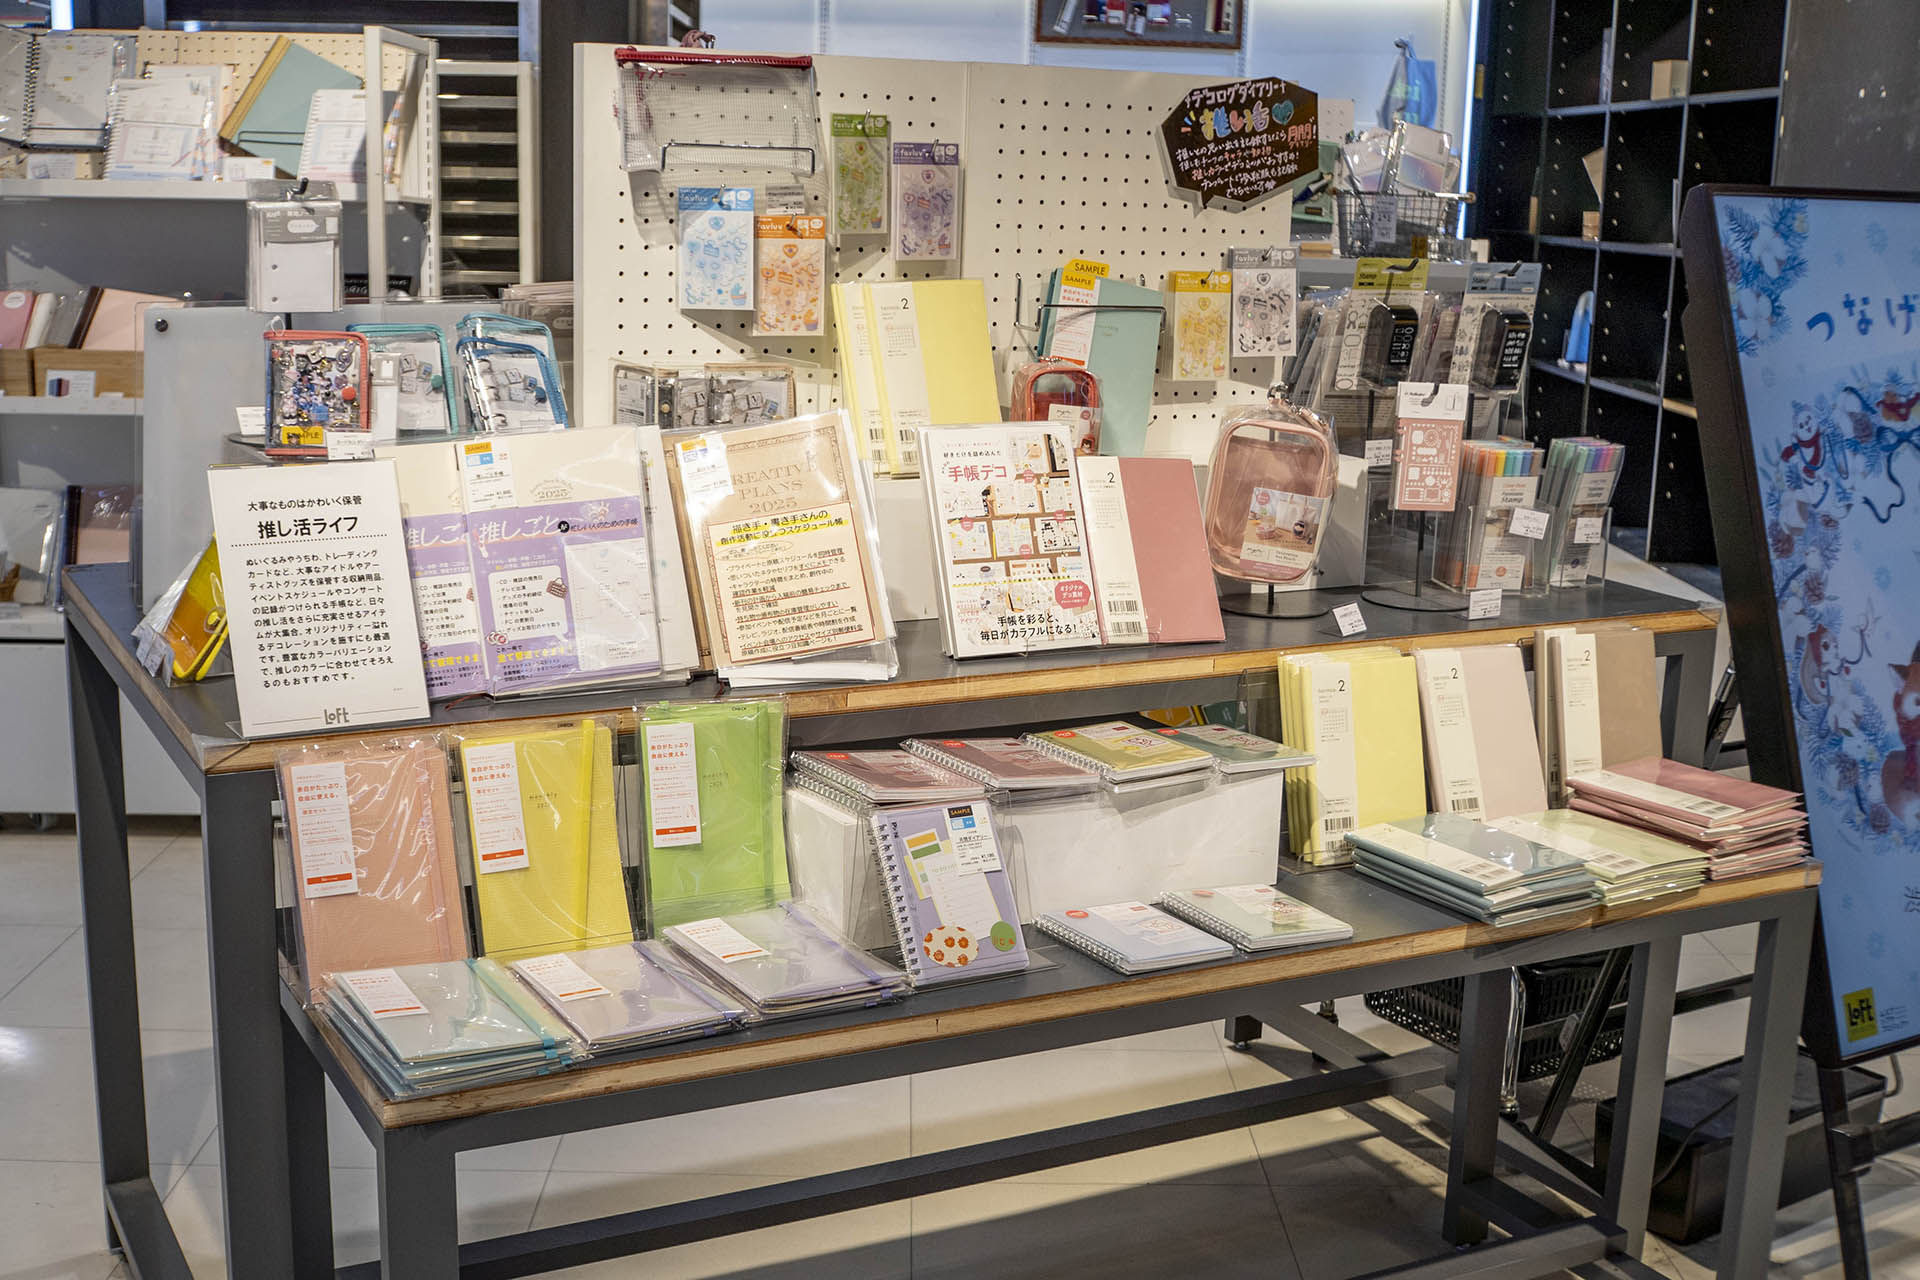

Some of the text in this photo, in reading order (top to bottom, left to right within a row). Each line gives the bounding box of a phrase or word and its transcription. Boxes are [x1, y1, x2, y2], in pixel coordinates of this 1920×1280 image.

[1199, 100, 1270, 141] 推し活
[1074, 262, 1105, 276] SAMPLE
[1065, 275, 1091, 286] SAMPLE
[901, 298, 909, 310] 2
[948, 464, 1007, 482] 手帳デコ
[1107, 471, 1116, 484] 2
[740, 479, 803, 501] PLANS
[247, 494, 362, 512] 大事なものはかわいく保管
[750, 496, 798, 514] 2025
[257, 516, 360, 539] 推し活ライフ
[478, 514, 562, 543] 推しごと
[732, 509, 829, 534] 描き手・書き手さんの
[246, 549, 378, 567] ぬいぐるみやうちわ、トレーディング
[247, 562, 380, 579] カードなど、大事なアイドルやアー
[251, 585, 383, 603] イベントスケジュールやコンサート
[252, 597, 385, 615] の記録がつけられる手帳など、日々
[254, 609, 386, 628] の推し活をさらに充実させるアイテ
[997, 613, 1059, 627] 手帳を彩ると、
[256, 621, 389, 639] ムが大集合。オリジナリティー溢れ
[980, 624, 1078, 641] 毎日がカラフルになる!
[257, 632, 391, 652] るデコレーションを施すにも最適
[259, 644, 392, 664] です。豊富なカラーバリエーション
[1584, 650, 1591, 662] 2
[260, 656, 394, 676] で、推しのカラーに合わせてそろえ
[1451, 668, 1458, 679] 2
[263, 674, 356, 688] るのもおすすめです。
[1338, 680, 1345, 691] 2
[951, 808, 971, 816] SAMPLE
